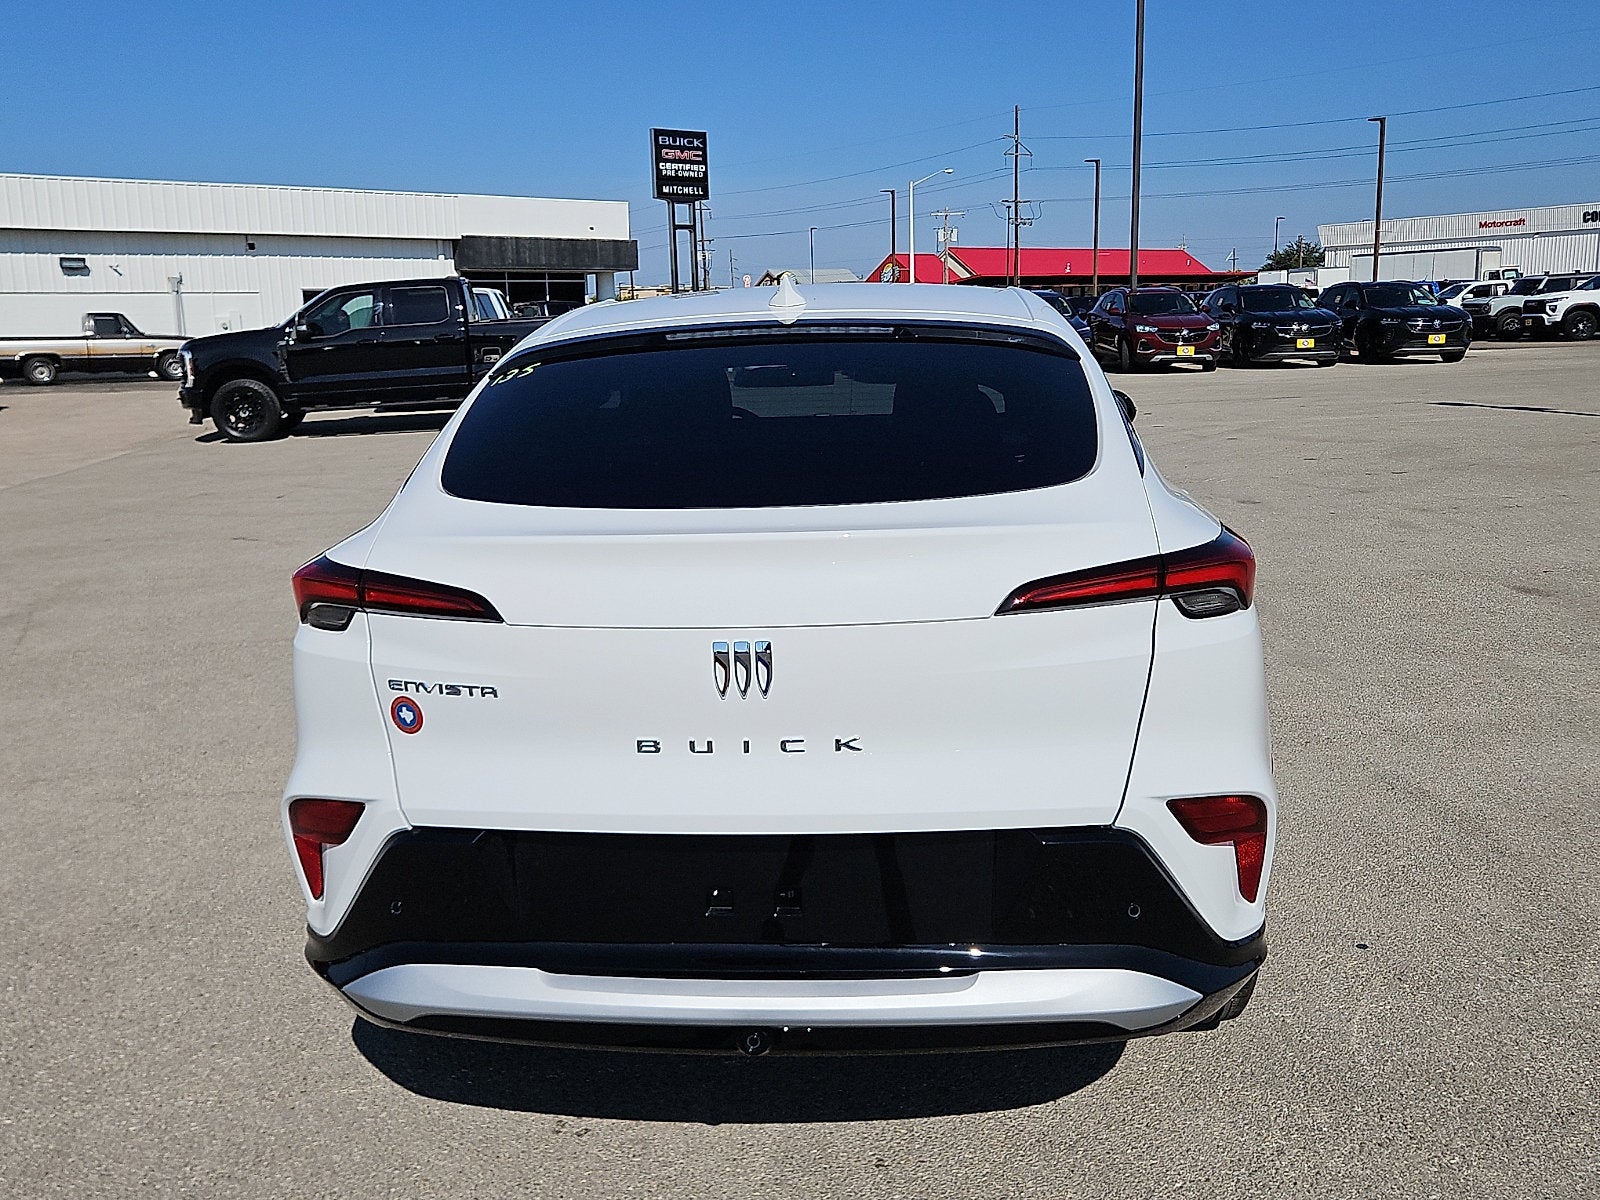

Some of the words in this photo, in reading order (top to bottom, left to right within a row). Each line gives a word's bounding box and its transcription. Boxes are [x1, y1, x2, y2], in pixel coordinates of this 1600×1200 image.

[659, 136, 703, 147] BUICK
[662, 149, 702, 161] GMC
[659, 162, 706, 171] CERTIFIED
[662, 185, 704, 194] MITCHELL
[1479, 218, 1526, 229] Motorcraft
[387, 679, 499, 698] ENVISTA
[636, 736, 863, 754] BUICK
